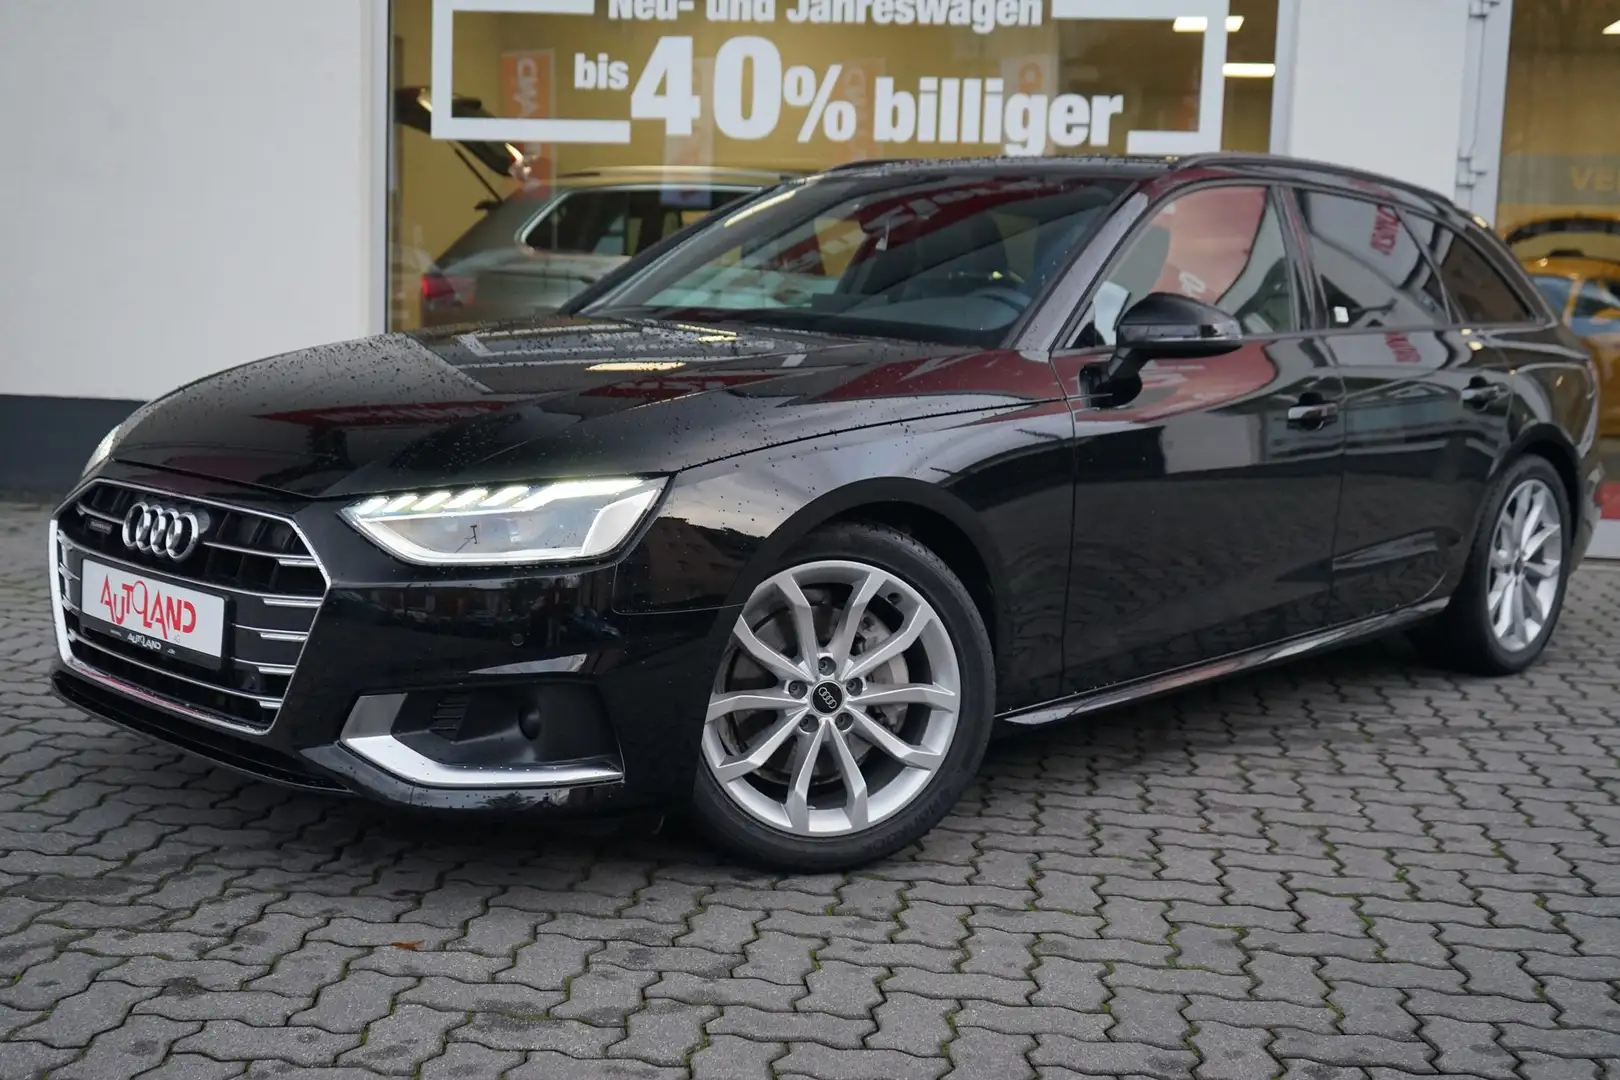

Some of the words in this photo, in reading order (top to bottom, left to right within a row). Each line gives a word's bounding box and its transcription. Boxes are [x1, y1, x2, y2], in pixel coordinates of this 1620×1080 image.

[609, 0, 695, 20] Neu-
[706, 0, 776, 22] und
[786, 0, 1043, 34] Jahreswagen
[574, 53, 629, 90] bis
[631, 35, 857, 143] 40%
[873, 76, 1124, 157] billiger
